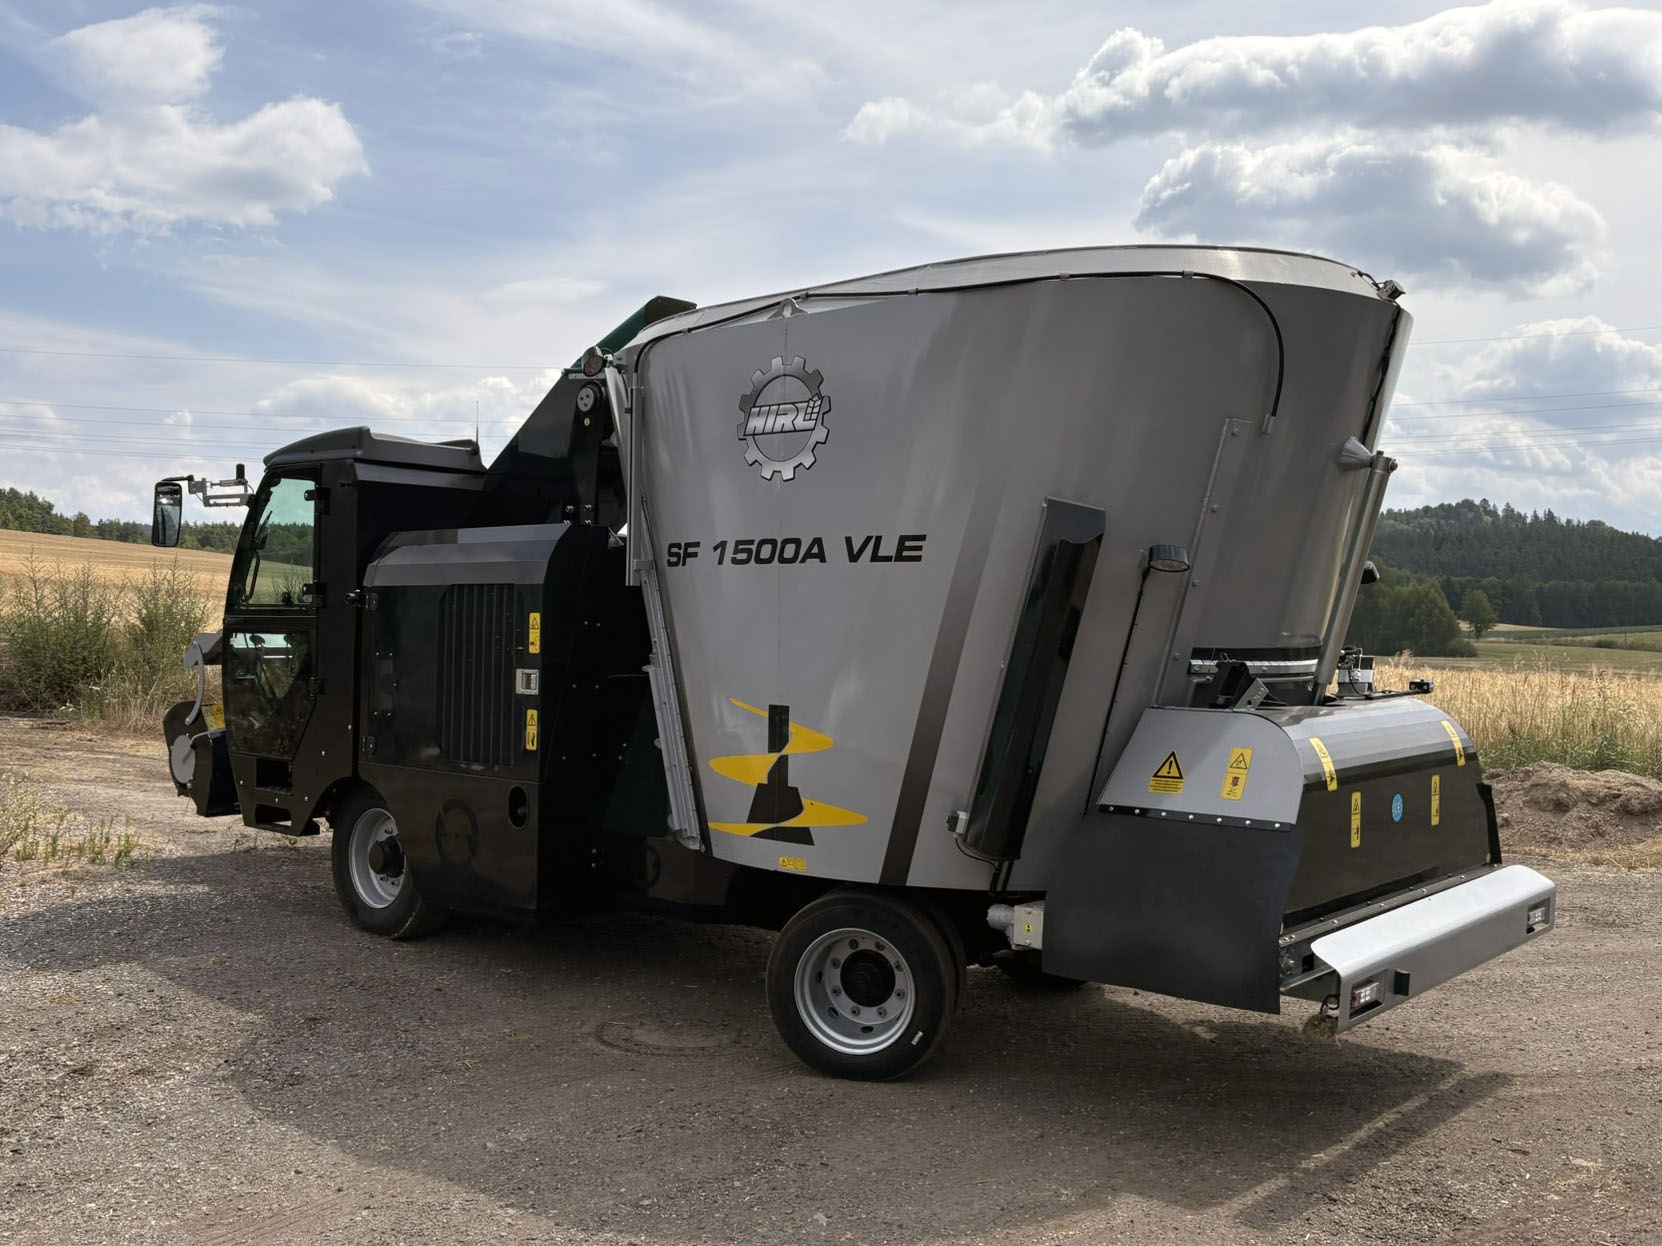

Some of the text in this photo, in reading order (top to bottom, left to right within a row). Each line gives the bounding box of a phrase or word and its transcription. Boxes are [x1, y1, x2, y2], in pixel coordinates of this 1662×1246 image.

[744, 400, 821, 436] HIRL
[667, 535, 926, 567] SF 1500A VLE
